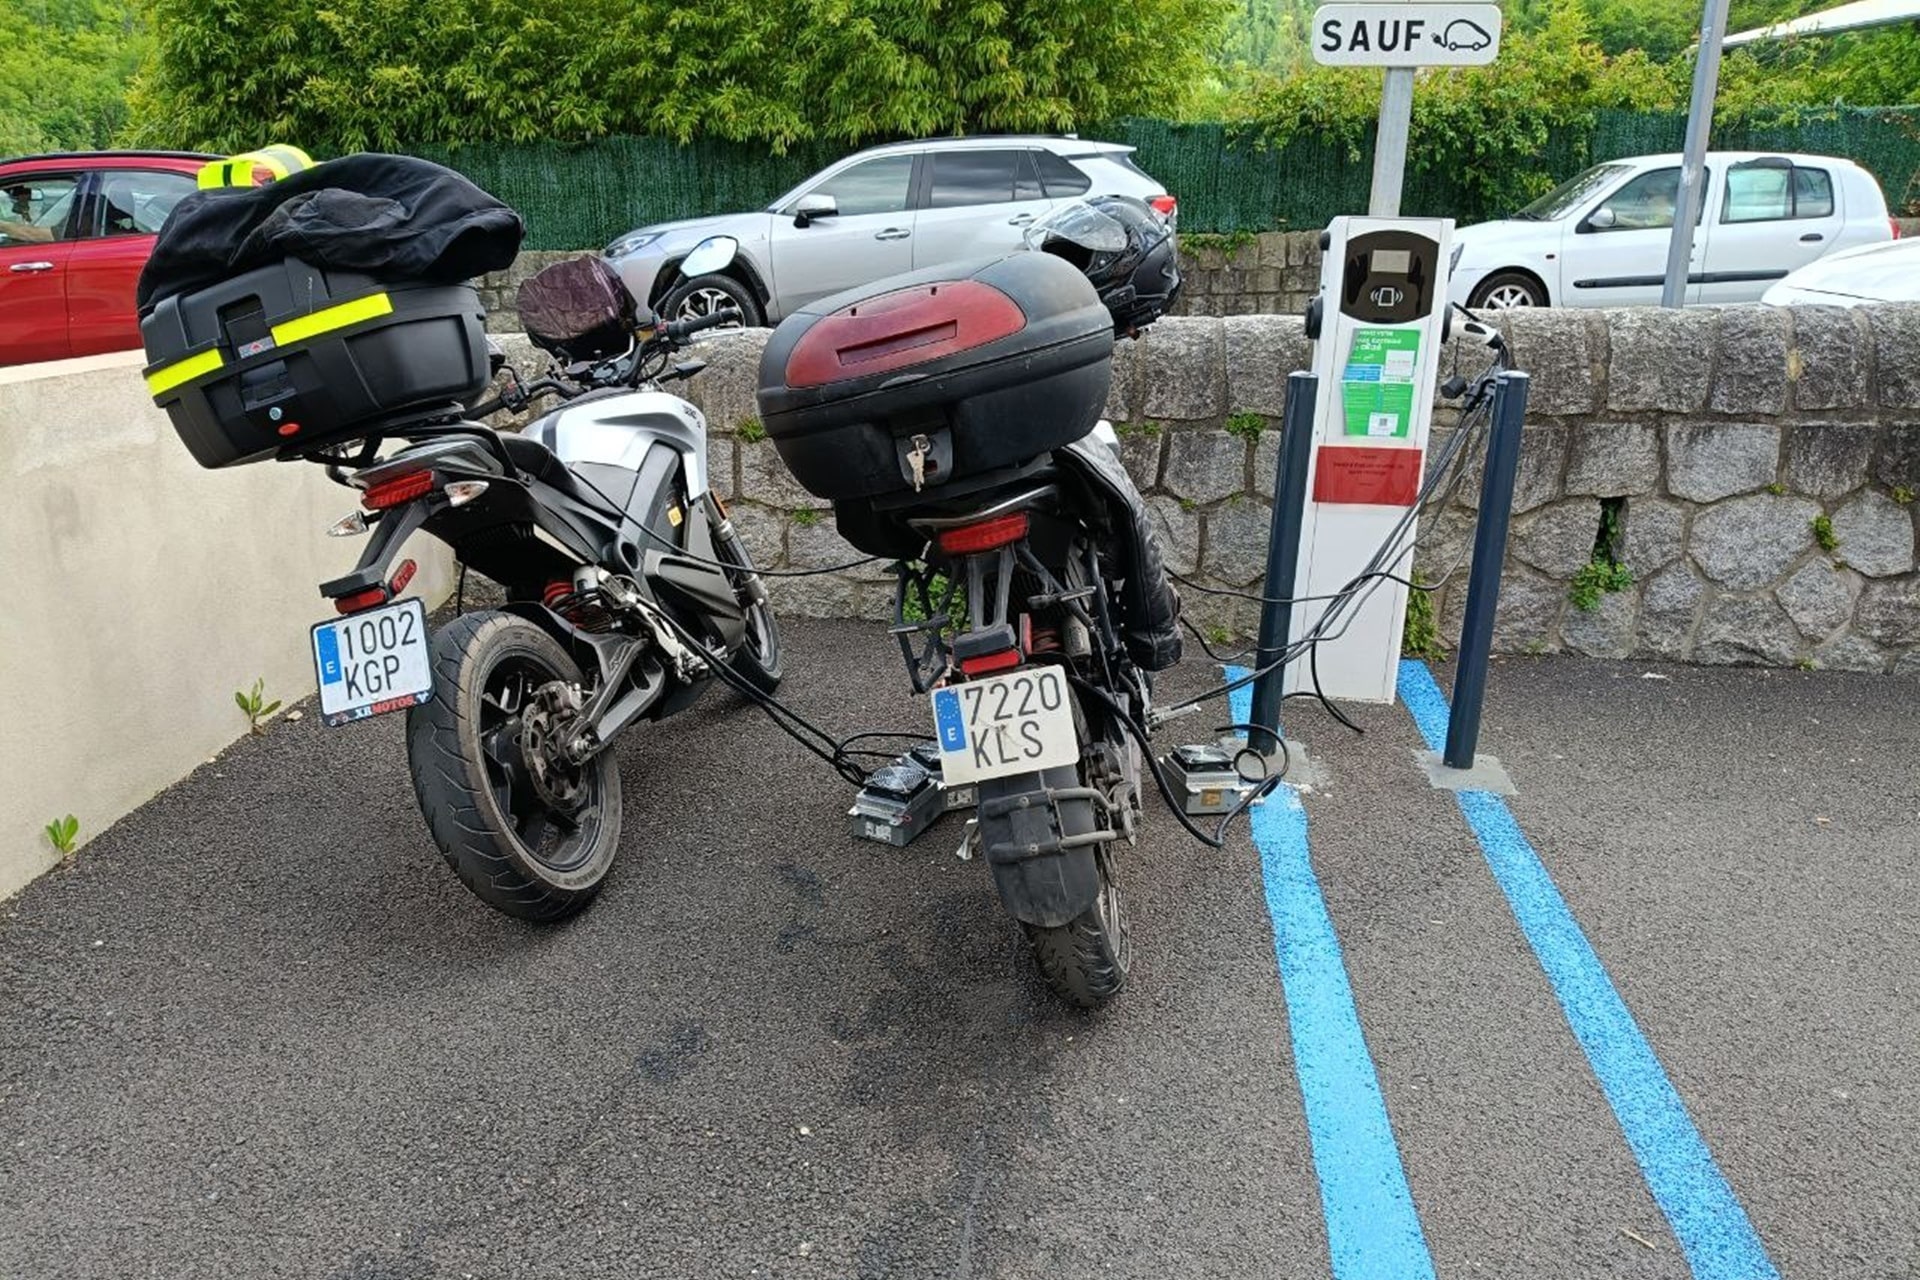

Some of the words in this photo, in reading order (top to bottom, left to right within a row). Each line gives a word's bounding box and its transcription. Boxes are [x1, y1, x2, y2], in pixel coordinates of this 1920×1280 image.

[1321, 20, 1425, 51] SAUF
[343, 611, 417, 660] 1002
[326, 661, 336, 674] E
[344, 655, 400, 700] KGP
[964, 673, 1061, 726] 7220
[947, 727, 957, 741] E
[971, 721, 1043, 768] KLS
